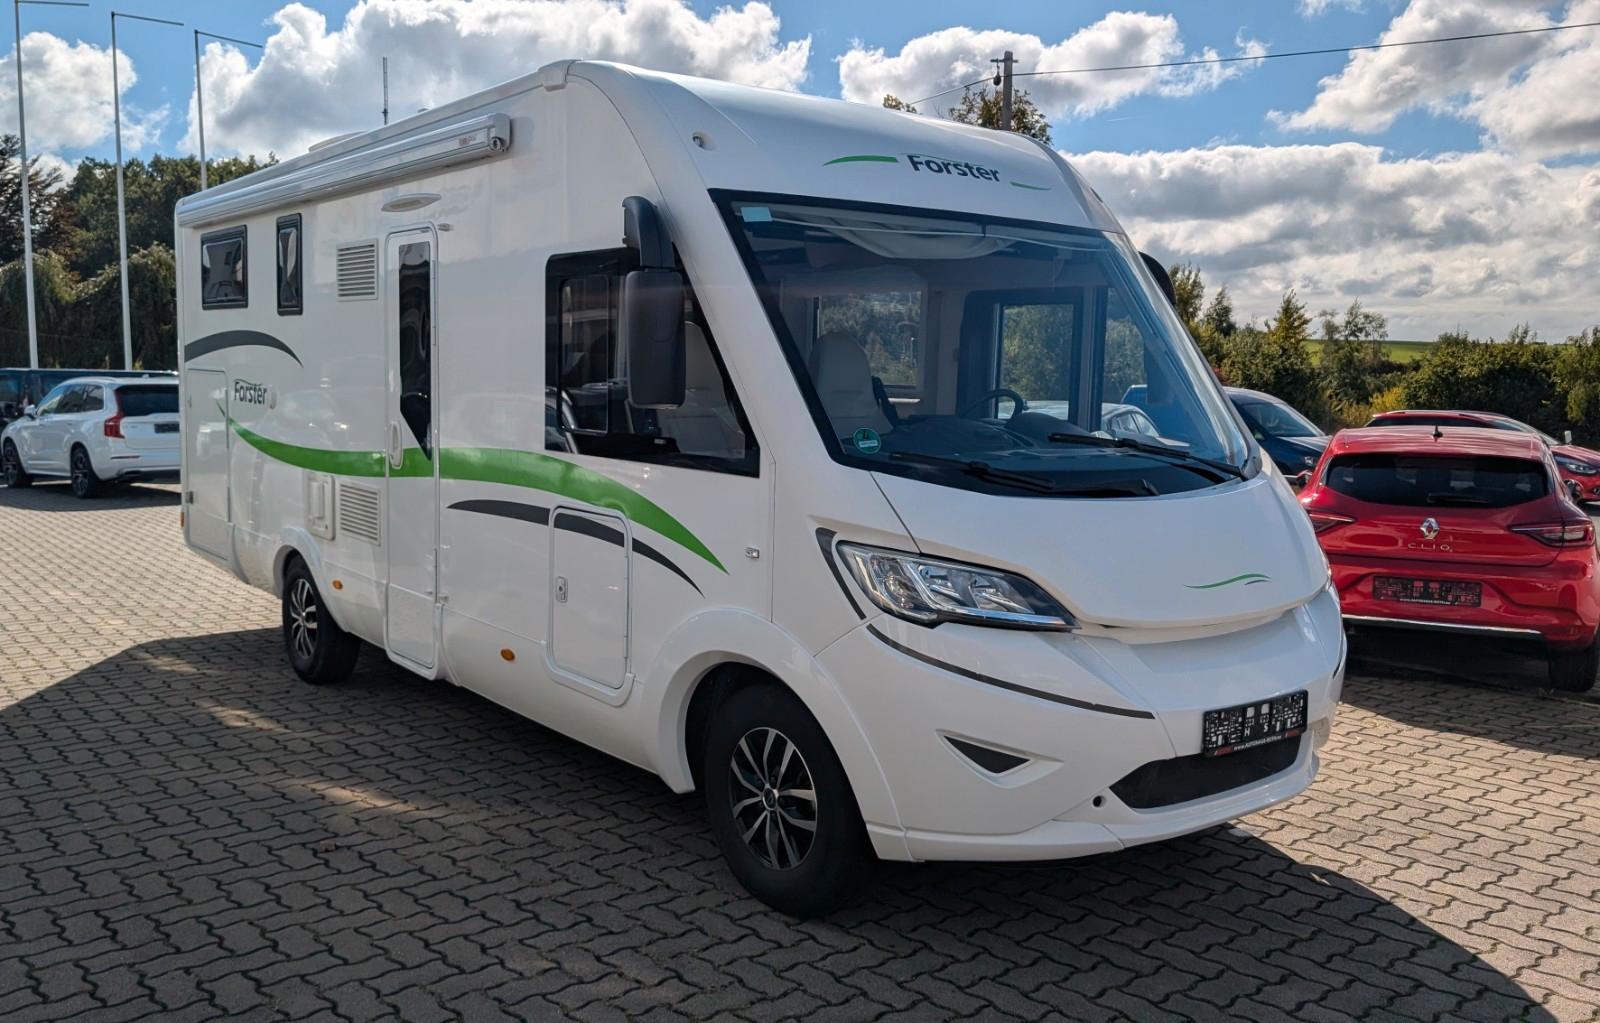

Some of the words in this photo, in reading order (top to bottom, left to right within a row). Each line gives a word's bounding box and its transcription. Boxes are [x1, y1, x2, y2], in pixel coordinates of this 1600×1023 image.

[907, 154, 1000, 182] Forster
[234, 381, 267, 404] Forster
[1408, 542, 1450, 550] CLIO
